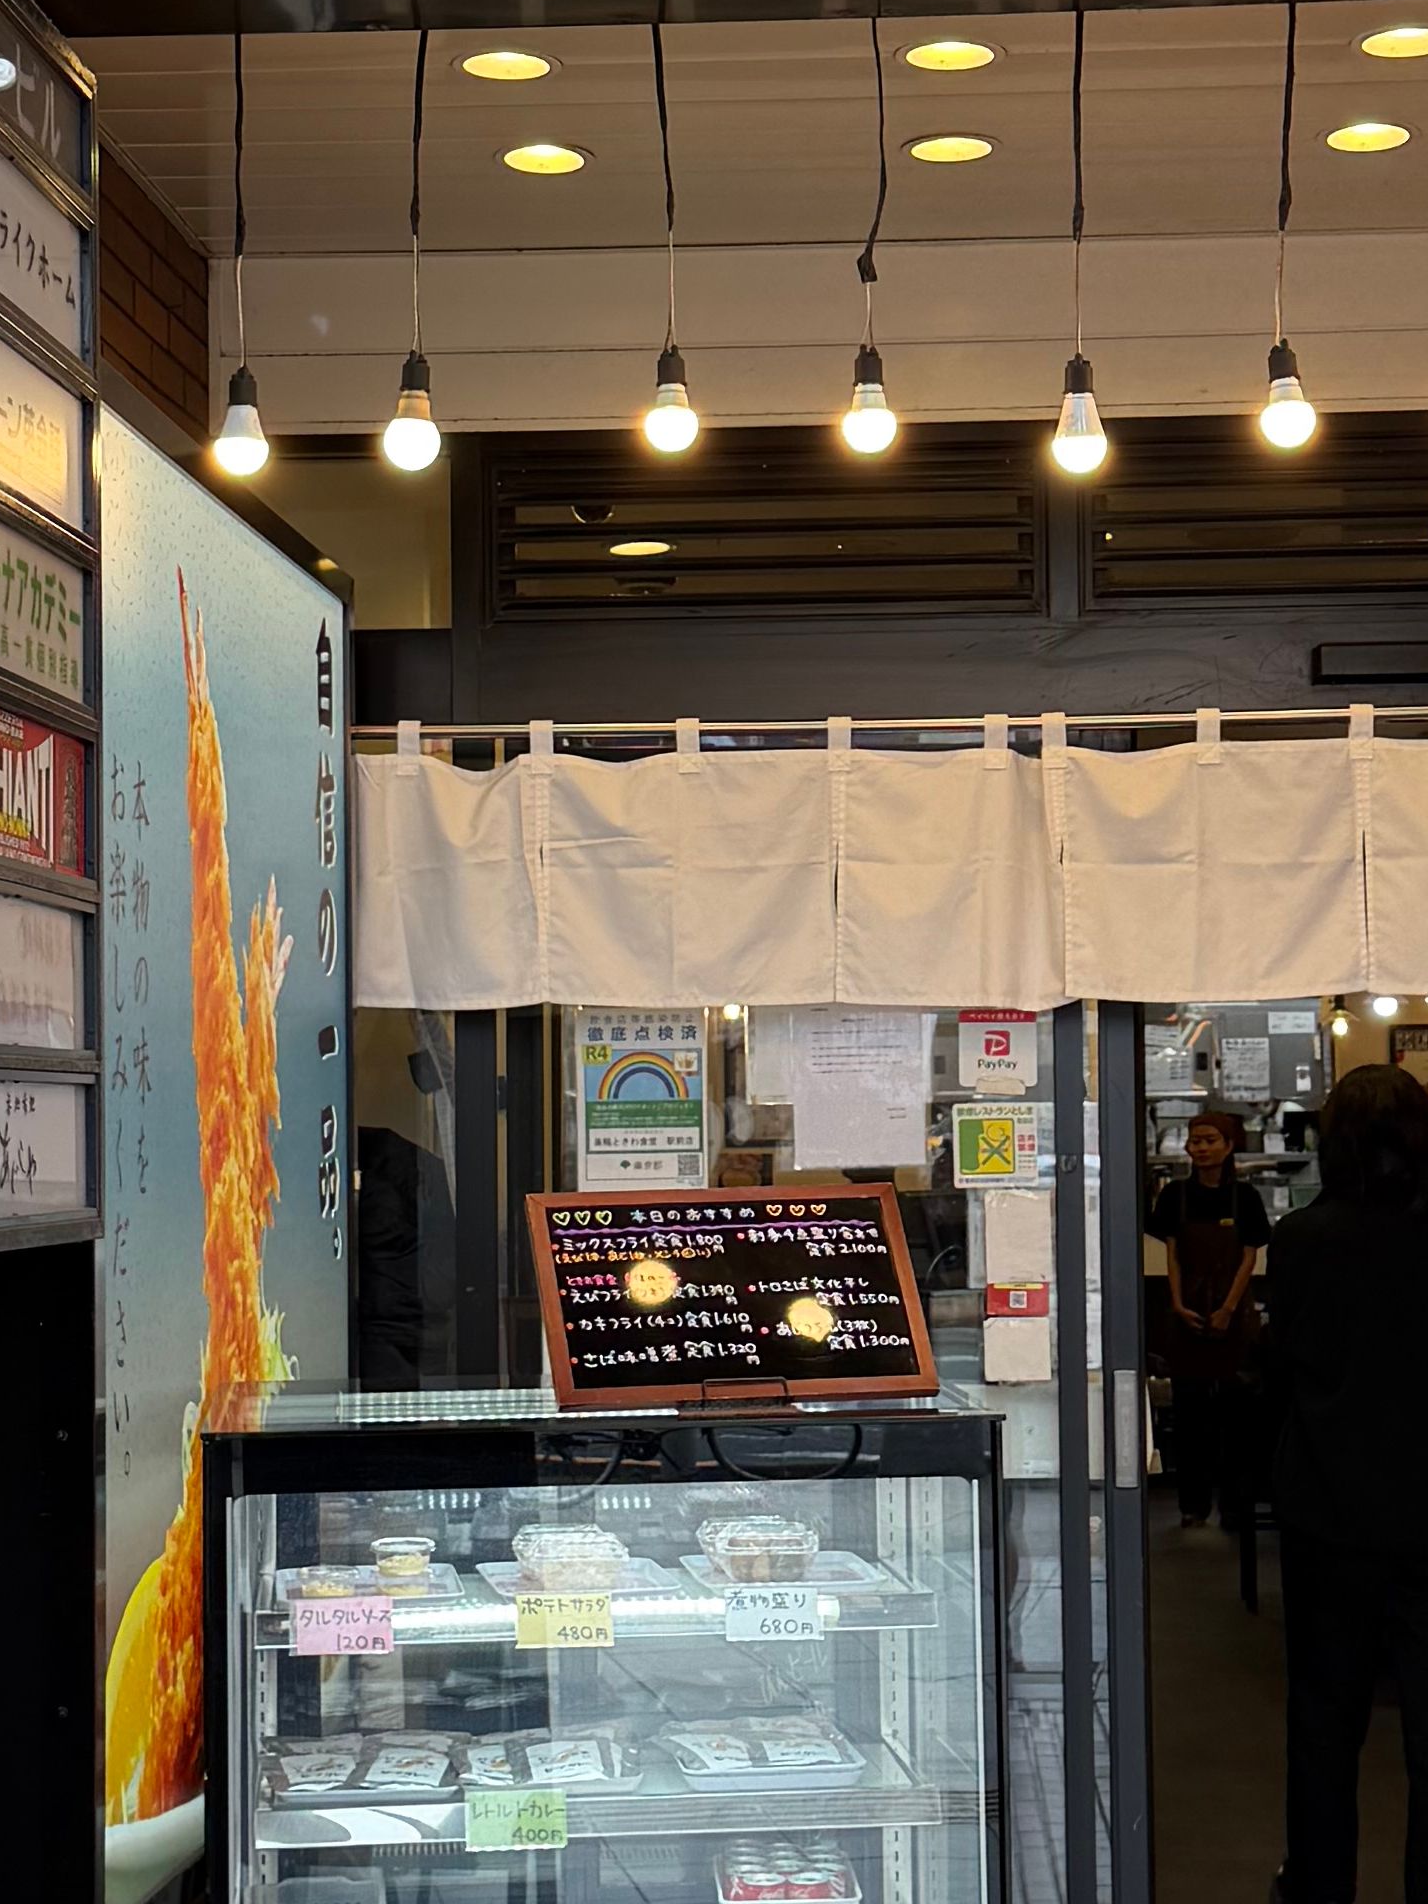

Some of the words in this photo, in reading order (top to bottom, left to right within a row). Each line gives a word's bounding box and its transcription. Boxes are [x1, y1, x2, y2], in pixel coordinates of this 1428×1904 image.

[132, 759, 152, 1195] 本物の味を
[585, 1045, 609, 1062] R4
[977, 1058, 1018, 1071] PayPay
[110, 753, 133, 1478] お楽しみください。
[630, 1207, 756, 1225] 本日のおすすめ
[521, 1594, 610, 1616] ポテトサラダ
[299, 1608, 392, 1628] タルタルソース
[759, 1617, 815, 1635] 680円
[336, 1634, 387, 1651] 120円
[557, 1625, 609, 1641] 480円
[470, 1800, 567, 1824] レトルトカレー
[510, 1825, 565, 1845] 400円
